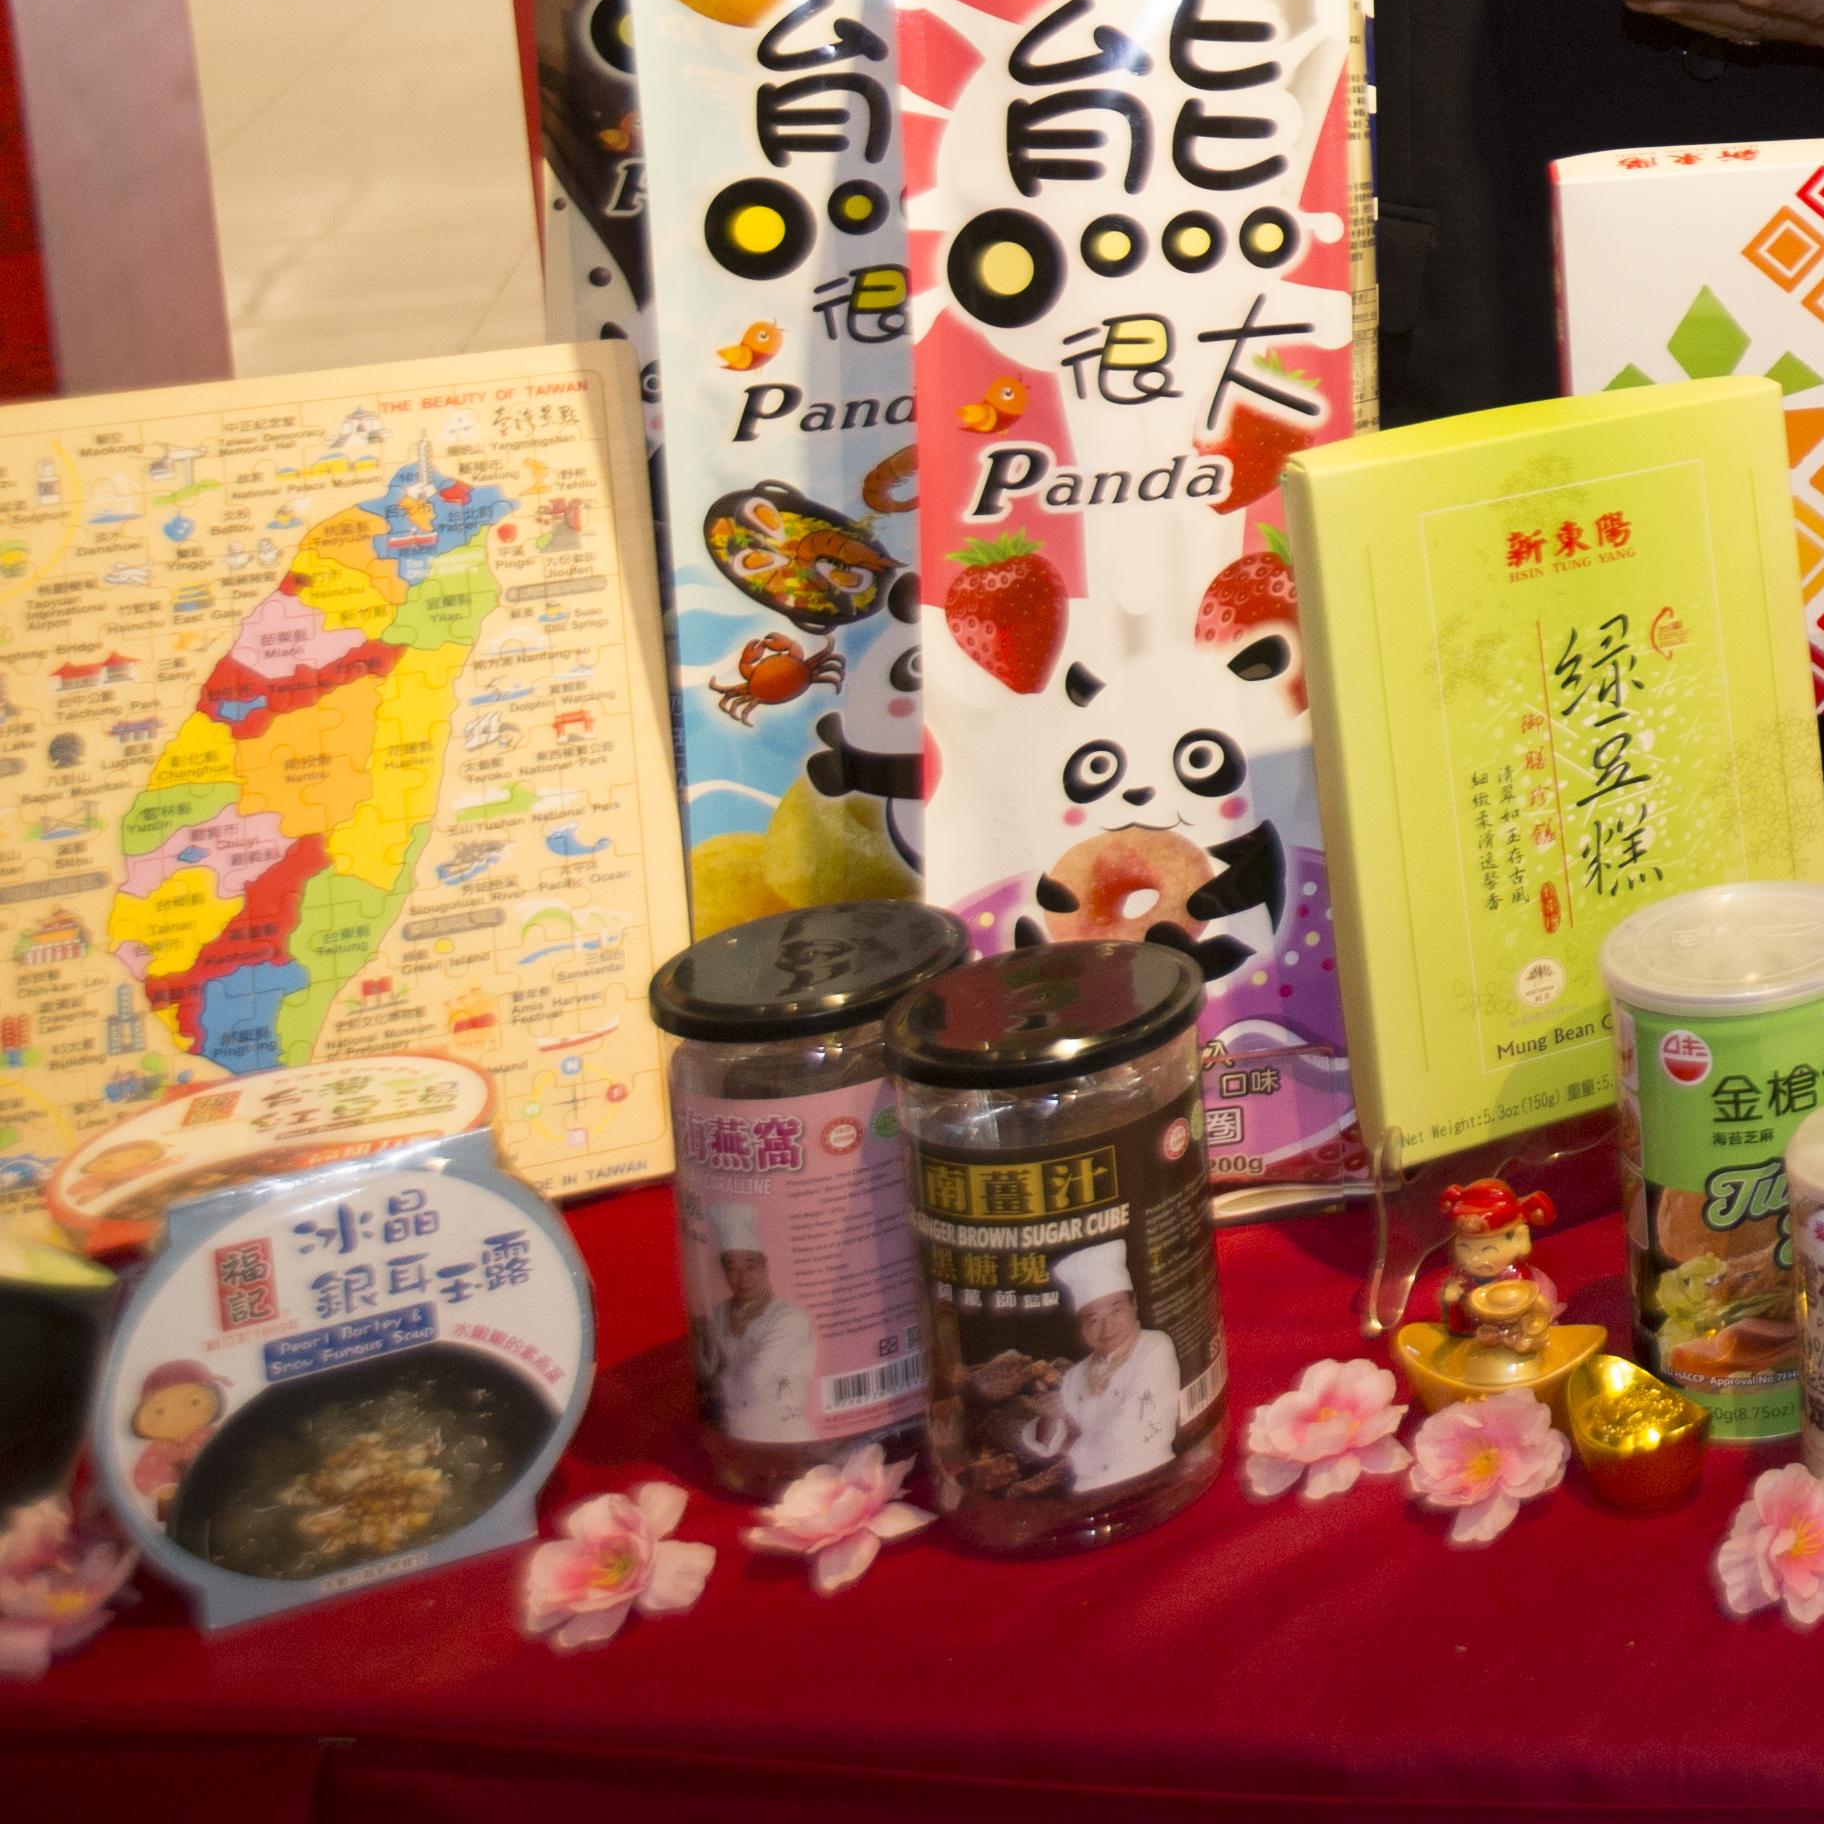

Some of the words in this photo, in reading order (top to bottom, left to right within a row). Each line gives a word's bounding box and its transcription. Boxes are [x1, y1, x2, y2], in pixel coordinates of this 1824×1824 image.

[1063, 293, 1323, 429] 很大
[381, 401, 413, 414] THE
[422, 392, 487, 410] BEAUTY
[496, 388, 515, 401] OF
[526, 380, 589, 397] TAIWAN
[733, 383, 916, 441] Pand
[975, 444, 1231, 523] Panda
[1506, 510, 1632, 567] 新東陽
[1509, 567, 1544, 583] HSIN
[1552, 558, 1591, 575] TUNG
[1597, 548, 1635, 566] YANG
[1553, 614, 1664, 896] 綠豆糕
[591, 869, 631, 883] Ocean
[402, 960, 442, 975] Green
[450, 952, 491, 965] Island
[1497, 1037, 1546, 1059] Mung
[1554, 1022, 1594, 1044] Bean
[1713, 1128, 1774, 1147] 海苔芝麻
[563, 1173, 578, 1186] IN
[586, 1160, 648, 1181] TAIWAN
[293, 1188, 440, 1255] 冰晶
[957, 1223, 1018, 1248] BROWN
[1022, 1217, 1083, 1247] SUGAR
[1085, 1203, 1130, 1237] CUBE
[220, 1245, 272, 1326] 福記
[270, 1356, 315, 1377] Snow
[322, 1340, 385, 1368] Fungus
[391, 1327, 435, 1351] Soup
[1710, 1375, 1756, 1387] Approval
